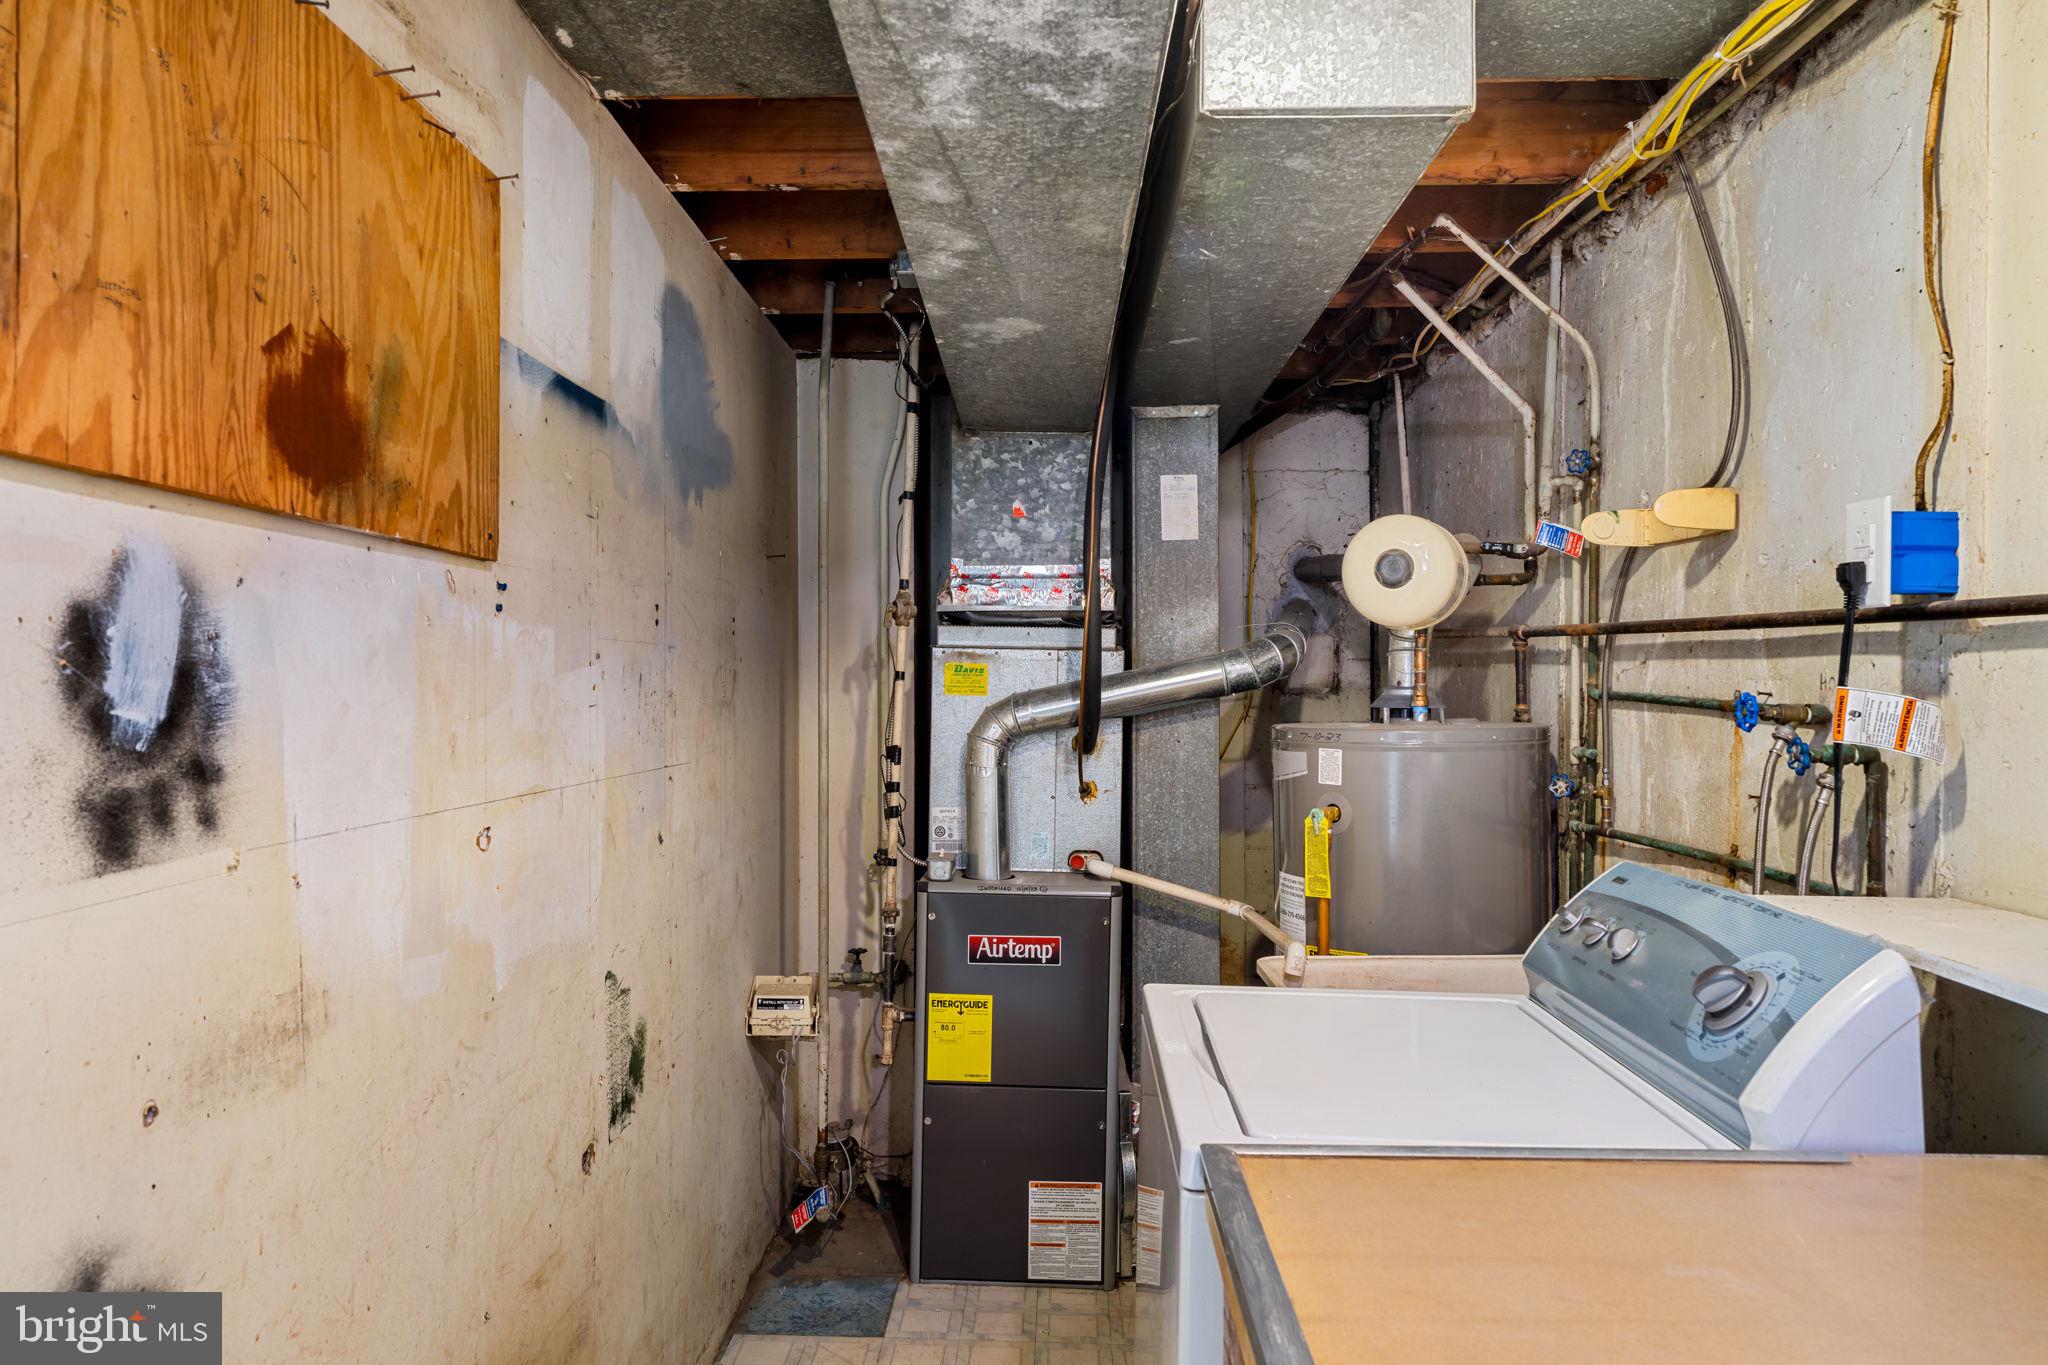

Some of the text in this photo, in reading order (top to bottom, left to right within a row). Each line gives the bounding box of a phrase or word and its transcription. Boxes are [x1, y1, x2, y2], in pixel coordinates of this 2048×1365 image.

[1836, 695, 1845, 731] WARNING
[1899, 700, 1914, 743] ADVERTENCIA
[976, 937, 1054, 964] Airtemp
[931, 999, 989, 1010] ENERGYGUIDE
[940, 1024, 956, 1032] 80.0
